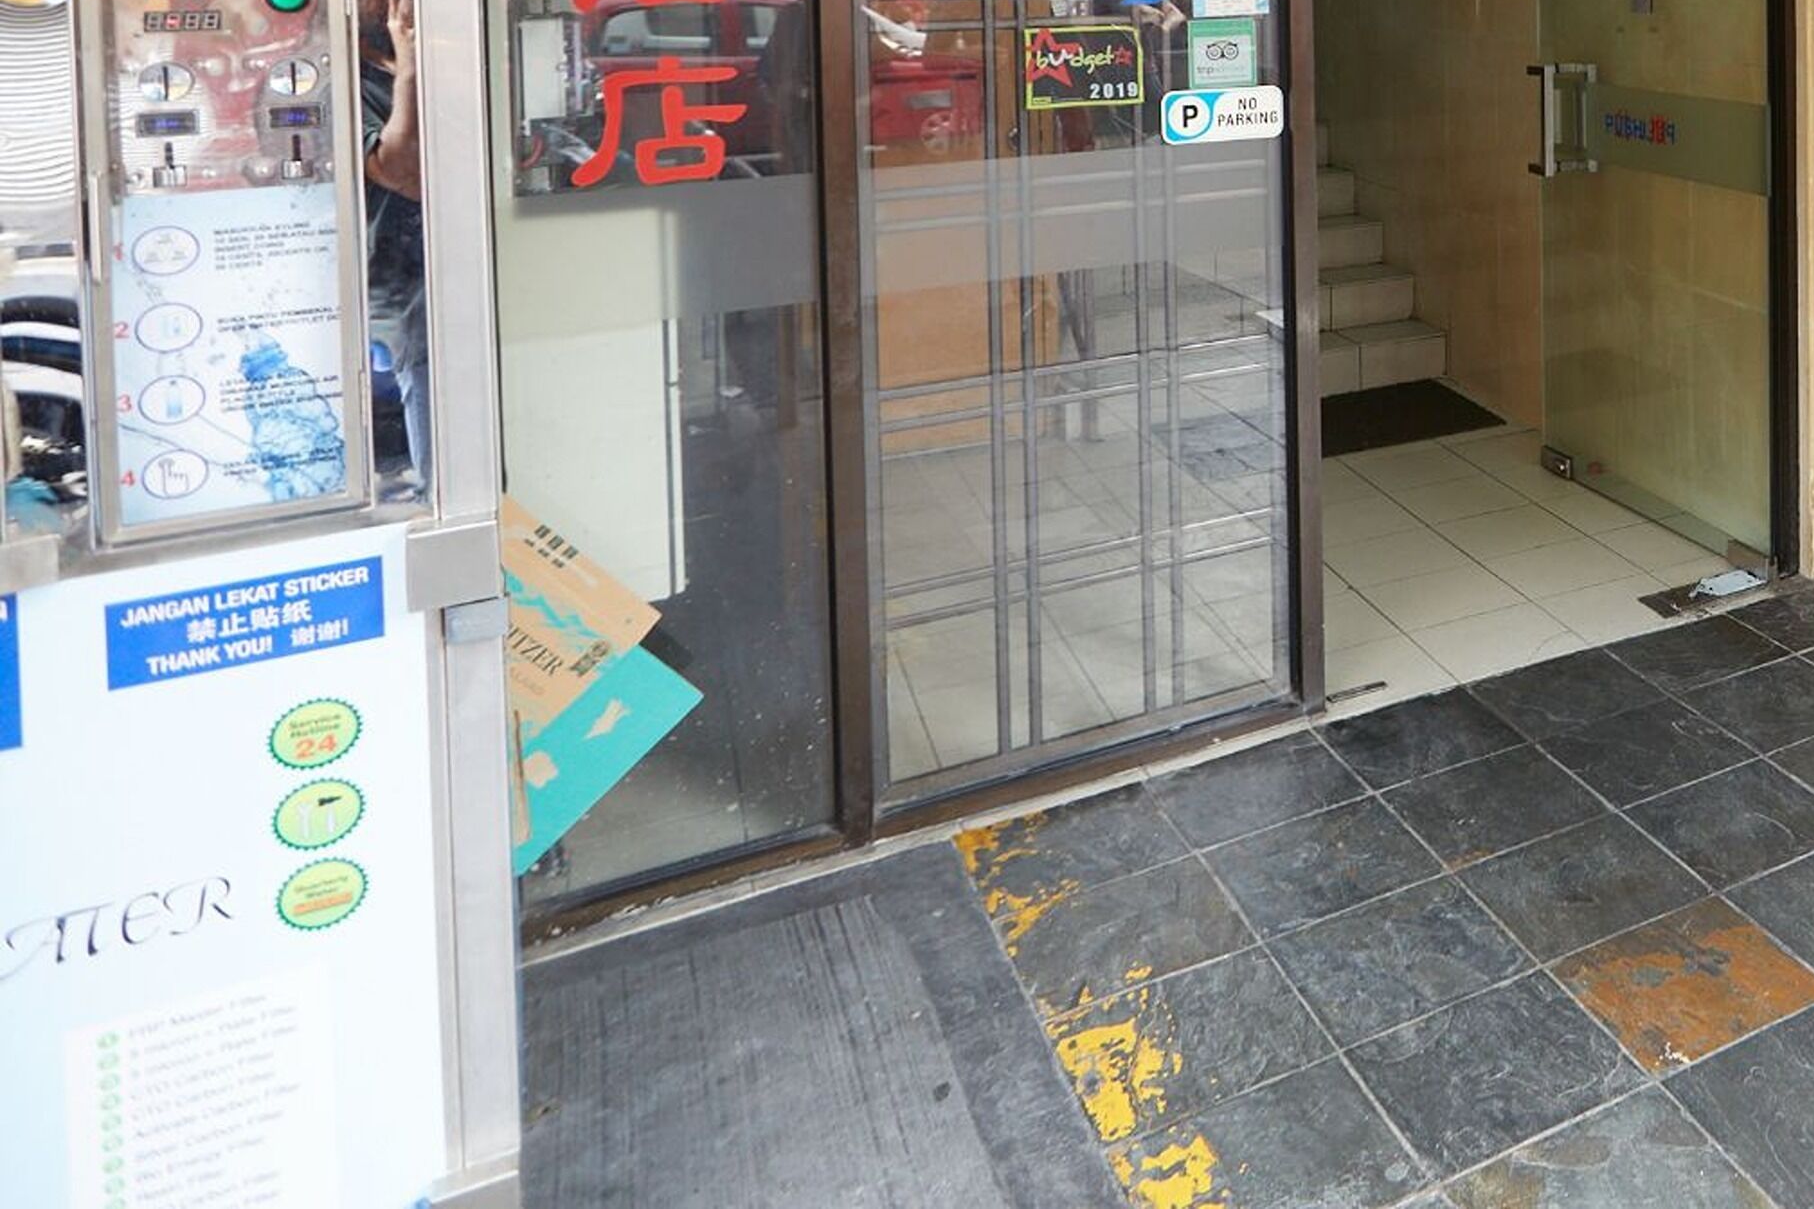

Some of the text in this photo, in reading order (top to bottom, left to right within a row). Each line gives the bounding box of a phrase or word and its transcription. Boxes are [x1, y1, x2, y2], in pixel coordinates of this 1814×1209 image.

[1036, 44, 1115, 75] budget
[1090, 81, 1138, 99] 2019
[1182, 98, 1257, 128] P NO
[1217, 110, 1279, 127] PARKING
[114, 321, 129, 339] 2
[121, 566, 369, 628] JANGAN LEKAT STICKER
[187, 599, 312, 643] 禁止贴纸
[146, 646, 221, 676] THANK
[224, 635, 273, 660] YOU!
[295, 734, 337, 760] 24
